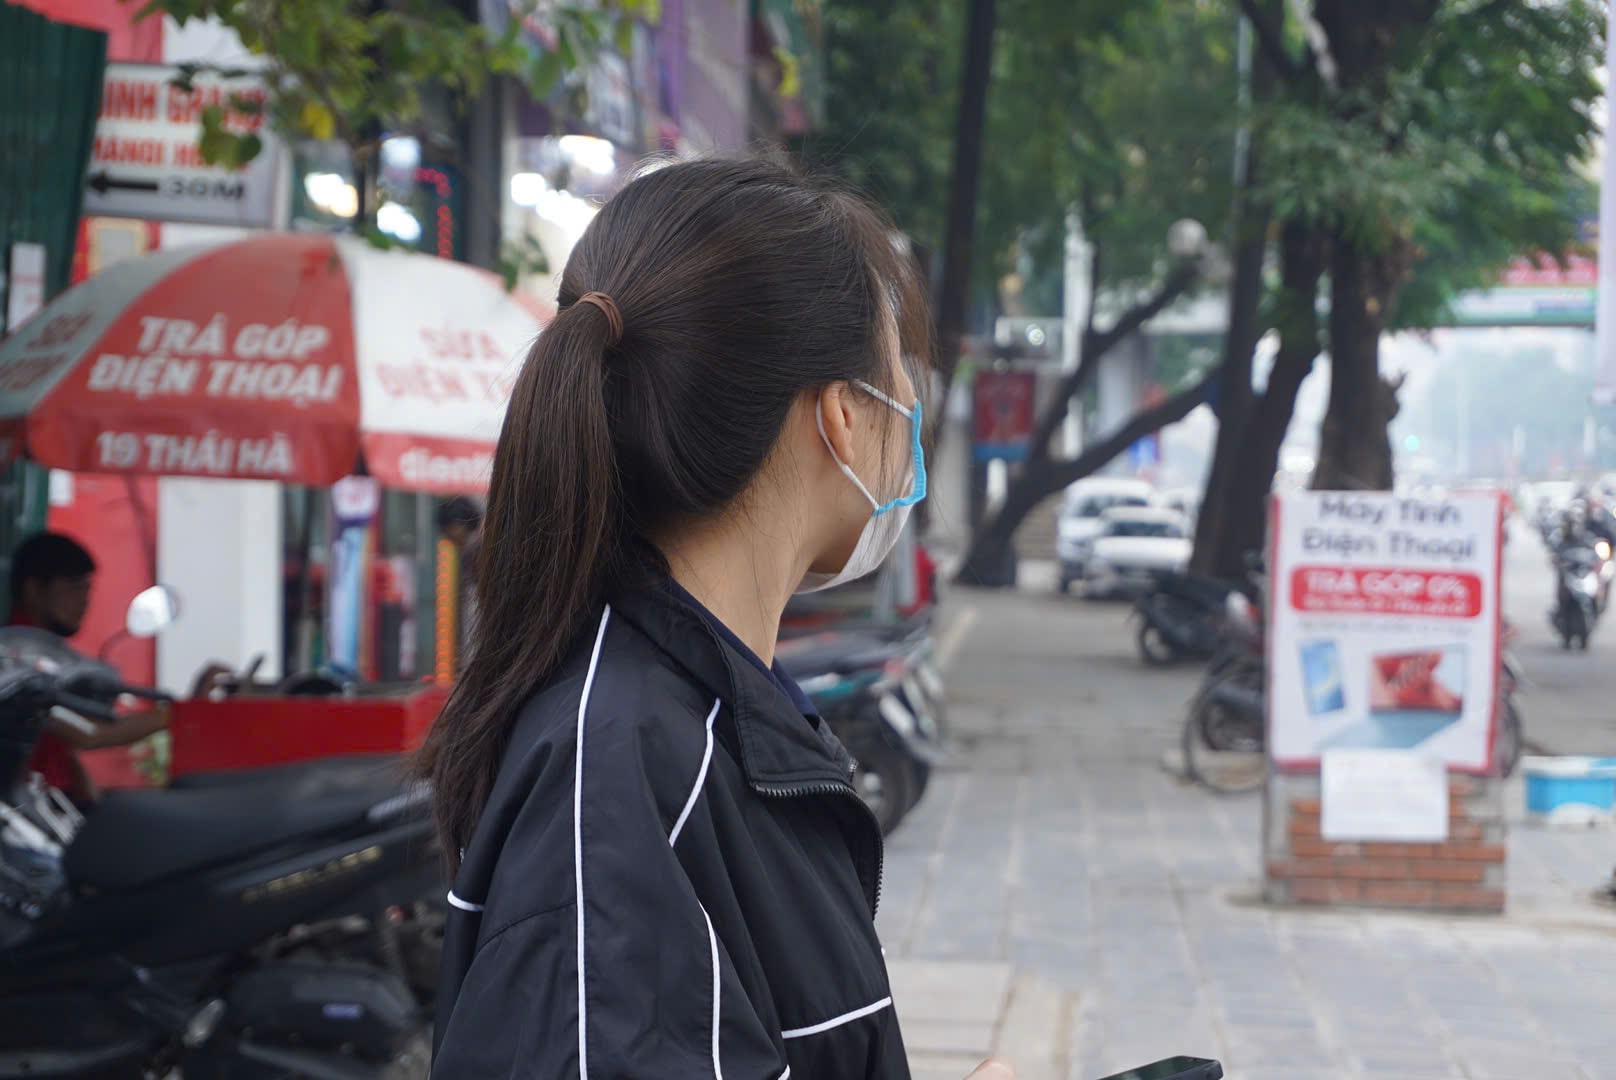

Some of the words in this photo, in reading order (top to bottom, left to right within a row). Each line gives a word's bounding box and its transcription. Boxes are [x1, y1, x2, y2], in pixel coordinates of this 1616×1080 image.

[234, 317, 331, 360] GÓP
[87, 351, 198, 401] ĐIỆN
[206, 359, 344, 409] THOẠI
[96, 430, 139, 468] 19
[145, 428, 235, 474] THÁI
[237, 430, 294, 474] HÀ
